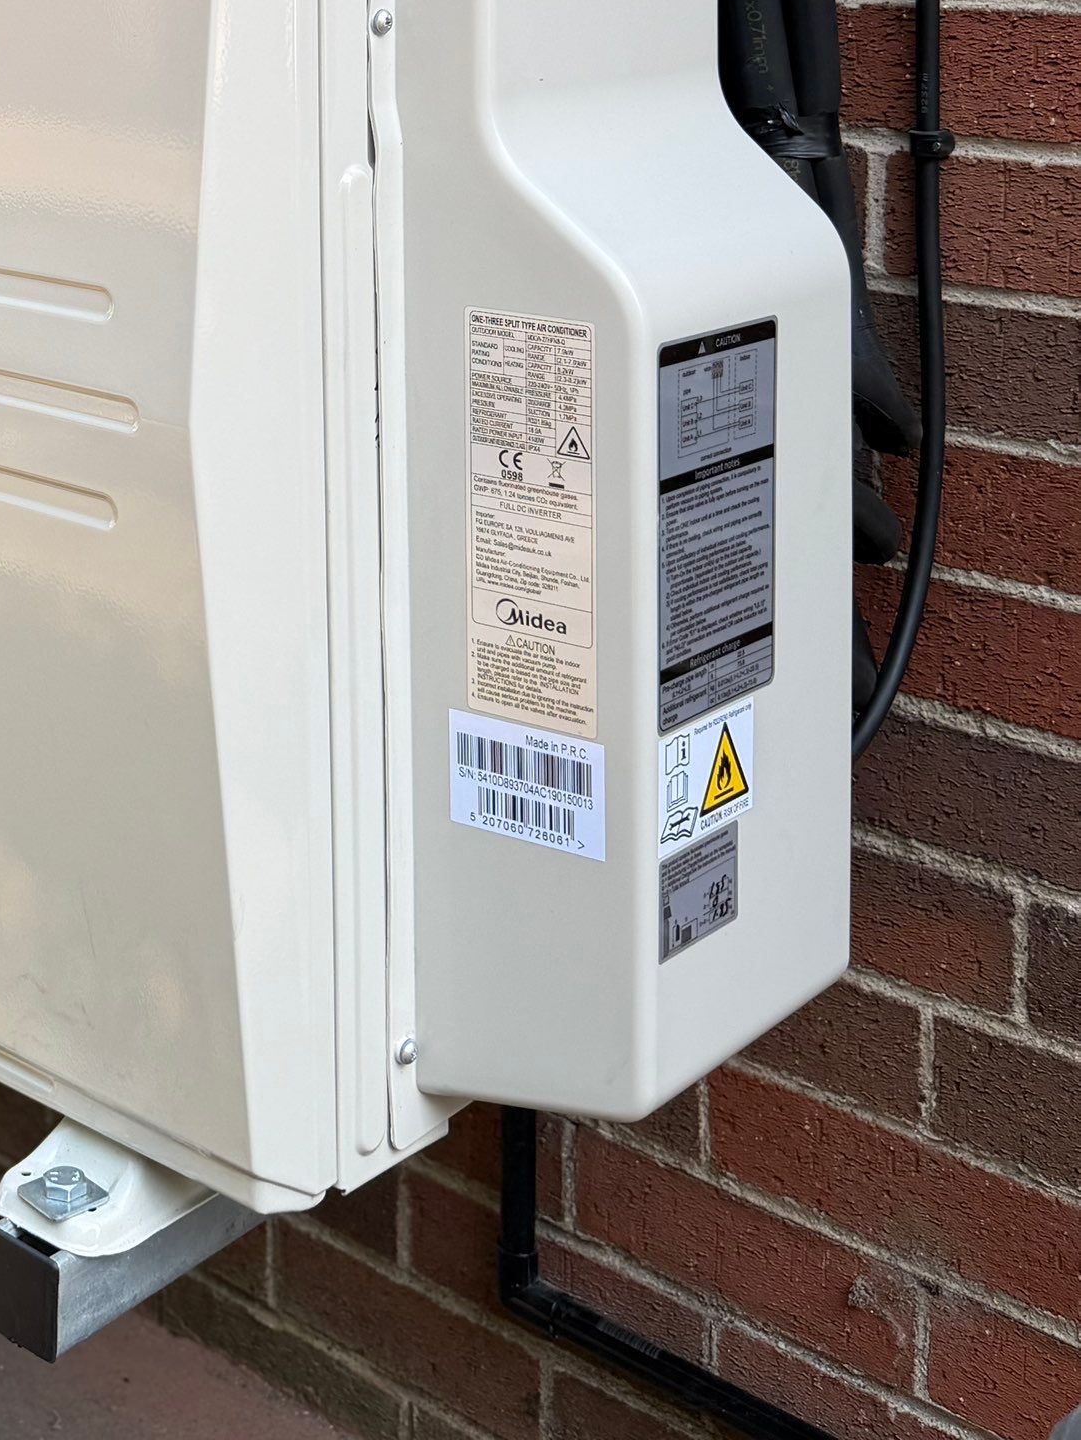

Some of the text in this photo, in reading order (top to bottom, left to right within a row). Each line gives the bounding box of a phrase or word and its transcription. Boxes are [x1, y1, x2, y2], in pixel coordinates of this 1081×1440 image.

[472, 315, 503, 326] ONE-THREE
[505, 319, 520, 328] SPLIT
[548, 325, 587, 338] CONDITIONER
[715, 333, 741, 348] CAUTION
[695, 457, 740, 481] Important notes
[474, 475, 497, 486] Contains
[527, 486, 559, 498] greenhouse
[528, 507, 562, 520] INVERTER
[541, 568, 568, 579] Equipment
[496, 596, 567, 638] Midea
[477, 640, 494, 648] Ensure
[516, 638, 555, 655] CAUTION
[690, 638, 741, 669] Refrigerant charge
[478, 673, 517, 687] INSTRUCTIONS
[540, 682, 579, 696] INSTALLATION
[663, 699, 684, 716] Additional
[663, 713, 678, 726] charge
[526, 735, 549, 751] Made
[561, 744, 589, 760] P.R.C.
[459, 766, 476, 781] S/N:
[700, 811, 722, 831] CAUTION
[483, 816, 523, 835] 207060
[528, 828, 569, 847] 726061
